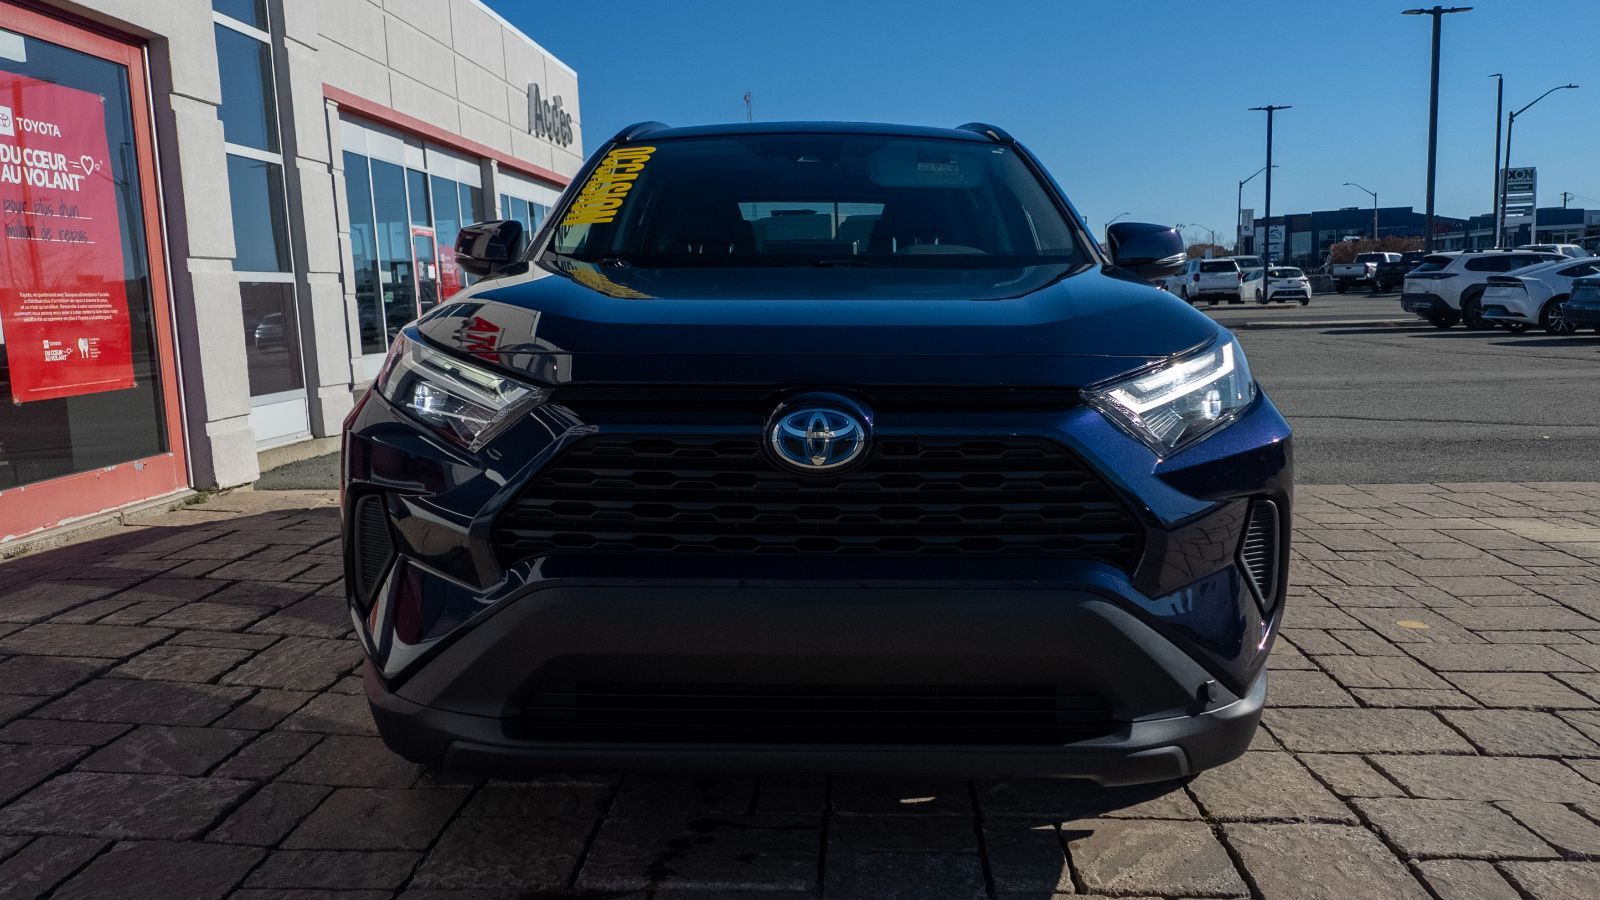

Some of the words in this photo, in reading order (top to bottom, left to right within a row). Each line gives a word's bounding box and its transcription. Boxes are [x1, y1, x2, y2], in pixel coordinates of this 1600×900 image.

[16, 117, 62, 138] TOYOTA
[0, 143, 22, 165] DU
[23, 148, 68, 172] CŒUR
[1, 164, 22, 185] AU
[23, 166, 81, 192] VOLANT
